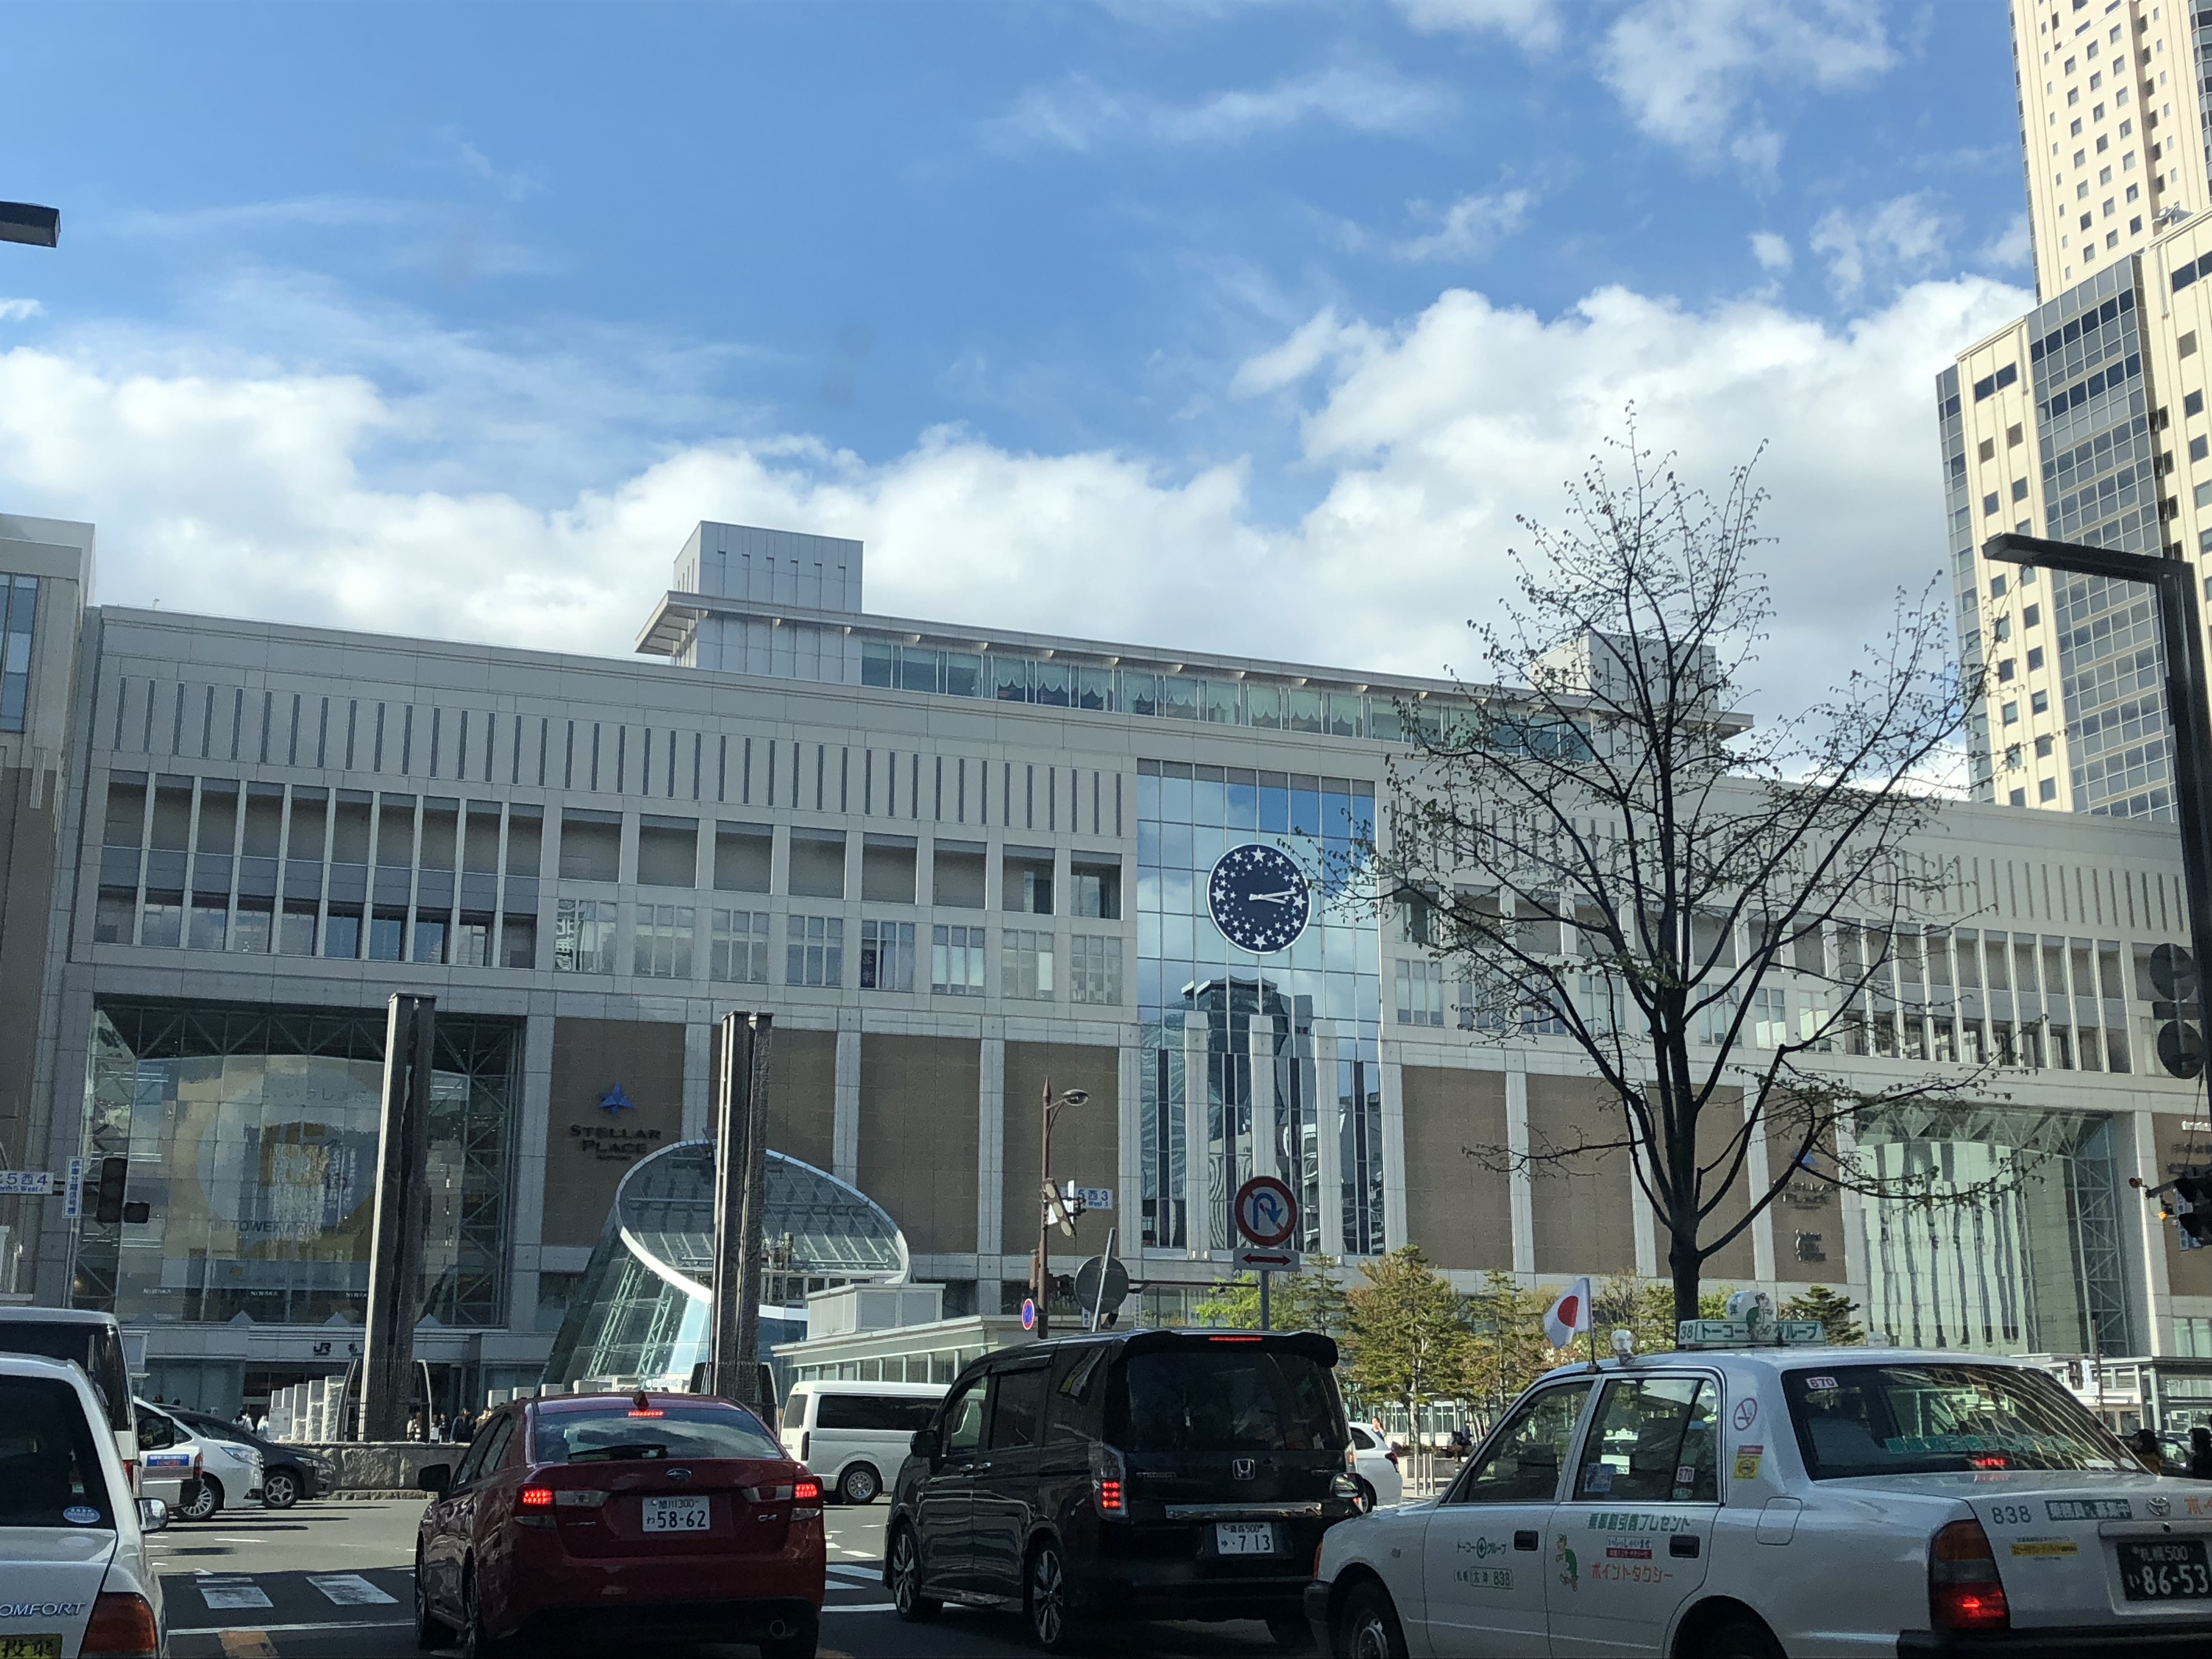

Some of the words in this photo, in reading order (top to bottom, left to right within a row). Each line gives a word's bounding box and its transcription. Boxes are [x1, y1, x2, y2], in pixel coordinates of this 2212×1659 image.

[570, 1125, 662, 1139] STELLAR
[582, 1140, 647, 1154] PLACE
[0, 1173, 48, 1186] 5西4
[1702, 1323, 1745, 1339] トーコー
[313, 1342, 331, 1353] JR
[1991, 1505, 2032, 1525] 838
[1493, 1571, 1511, 1586] 838
[2142, 1564, 2209, 1595] 86-53
[0, 1602, 86, 1617] OMFORT
